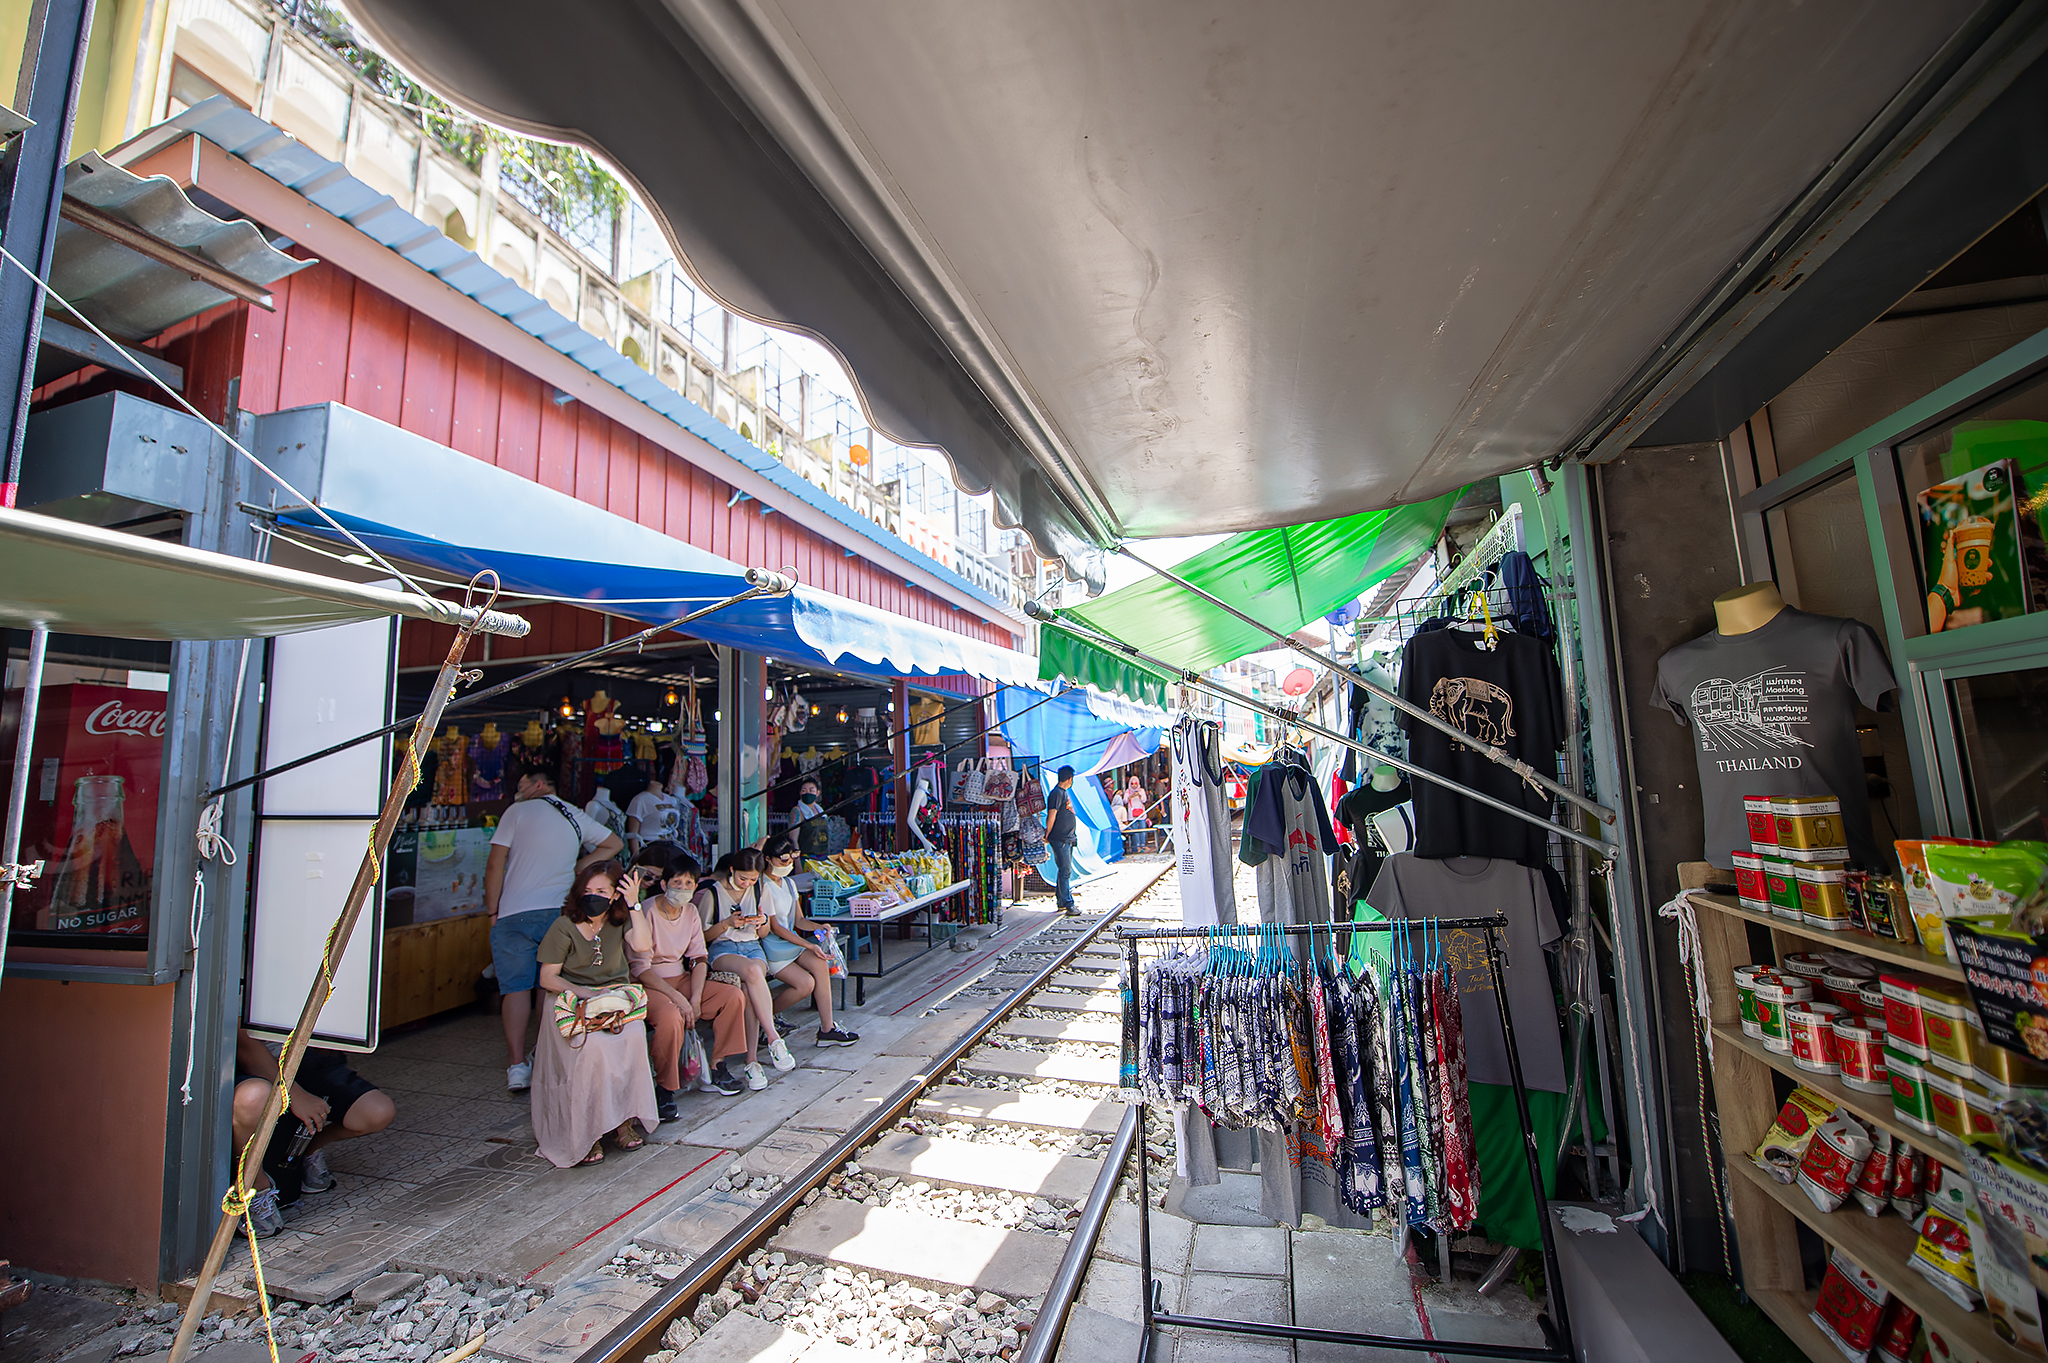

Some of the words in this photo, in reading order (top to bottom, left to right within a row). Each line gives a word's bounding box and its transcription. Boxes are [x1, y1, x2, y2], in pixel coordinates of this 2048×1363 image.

[1765, 685, 1805, 695] Maeklong
[1716, 756, 1802, 772] THAILAND
[57, 917, 82, 929] NO
[86, 906, 138, 926] SUGAR
